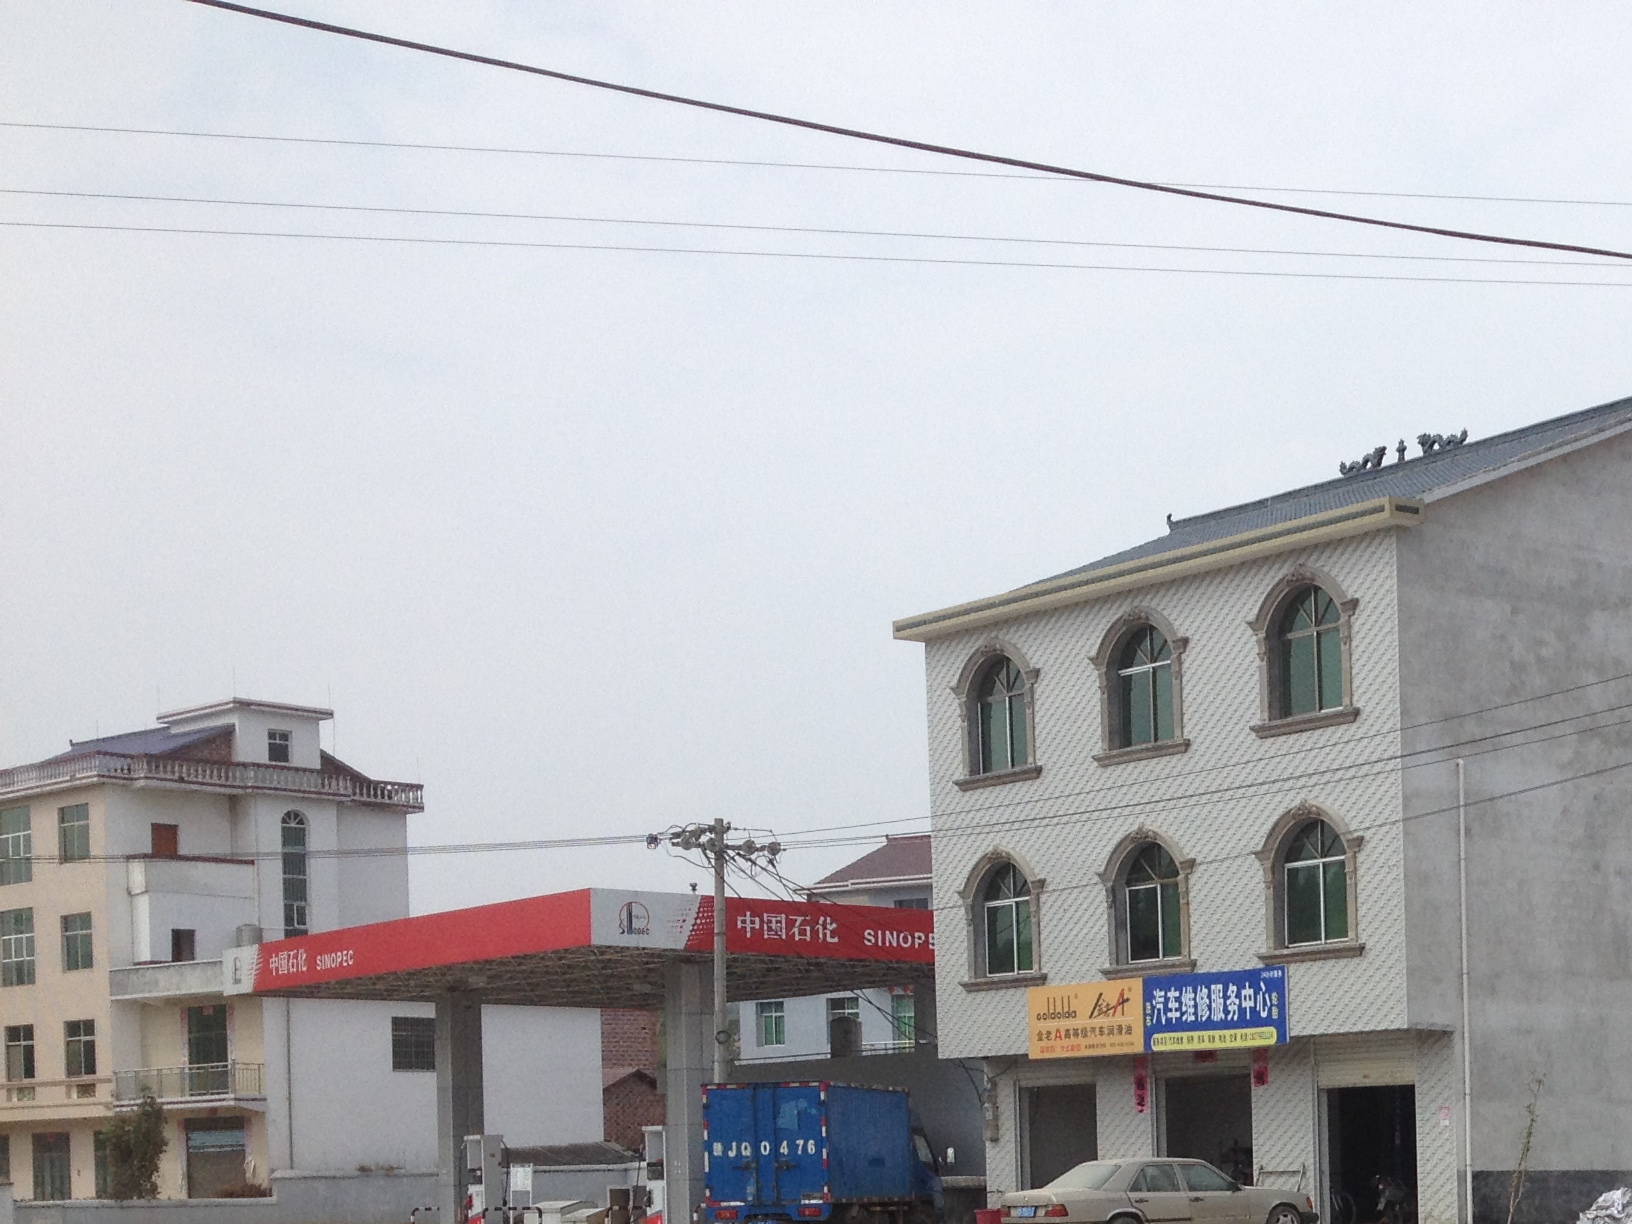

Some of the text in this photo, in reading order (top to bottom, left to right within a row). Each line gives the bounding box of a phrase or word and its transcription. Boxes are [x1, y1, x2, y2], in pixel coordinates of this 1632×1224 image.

[737, 911, 839, 943] 中国石化
[269, 949, 354, 976] 中国石化 SINOPEC
[1152, 981, 1271, 1026] 汽车维修服务中心
